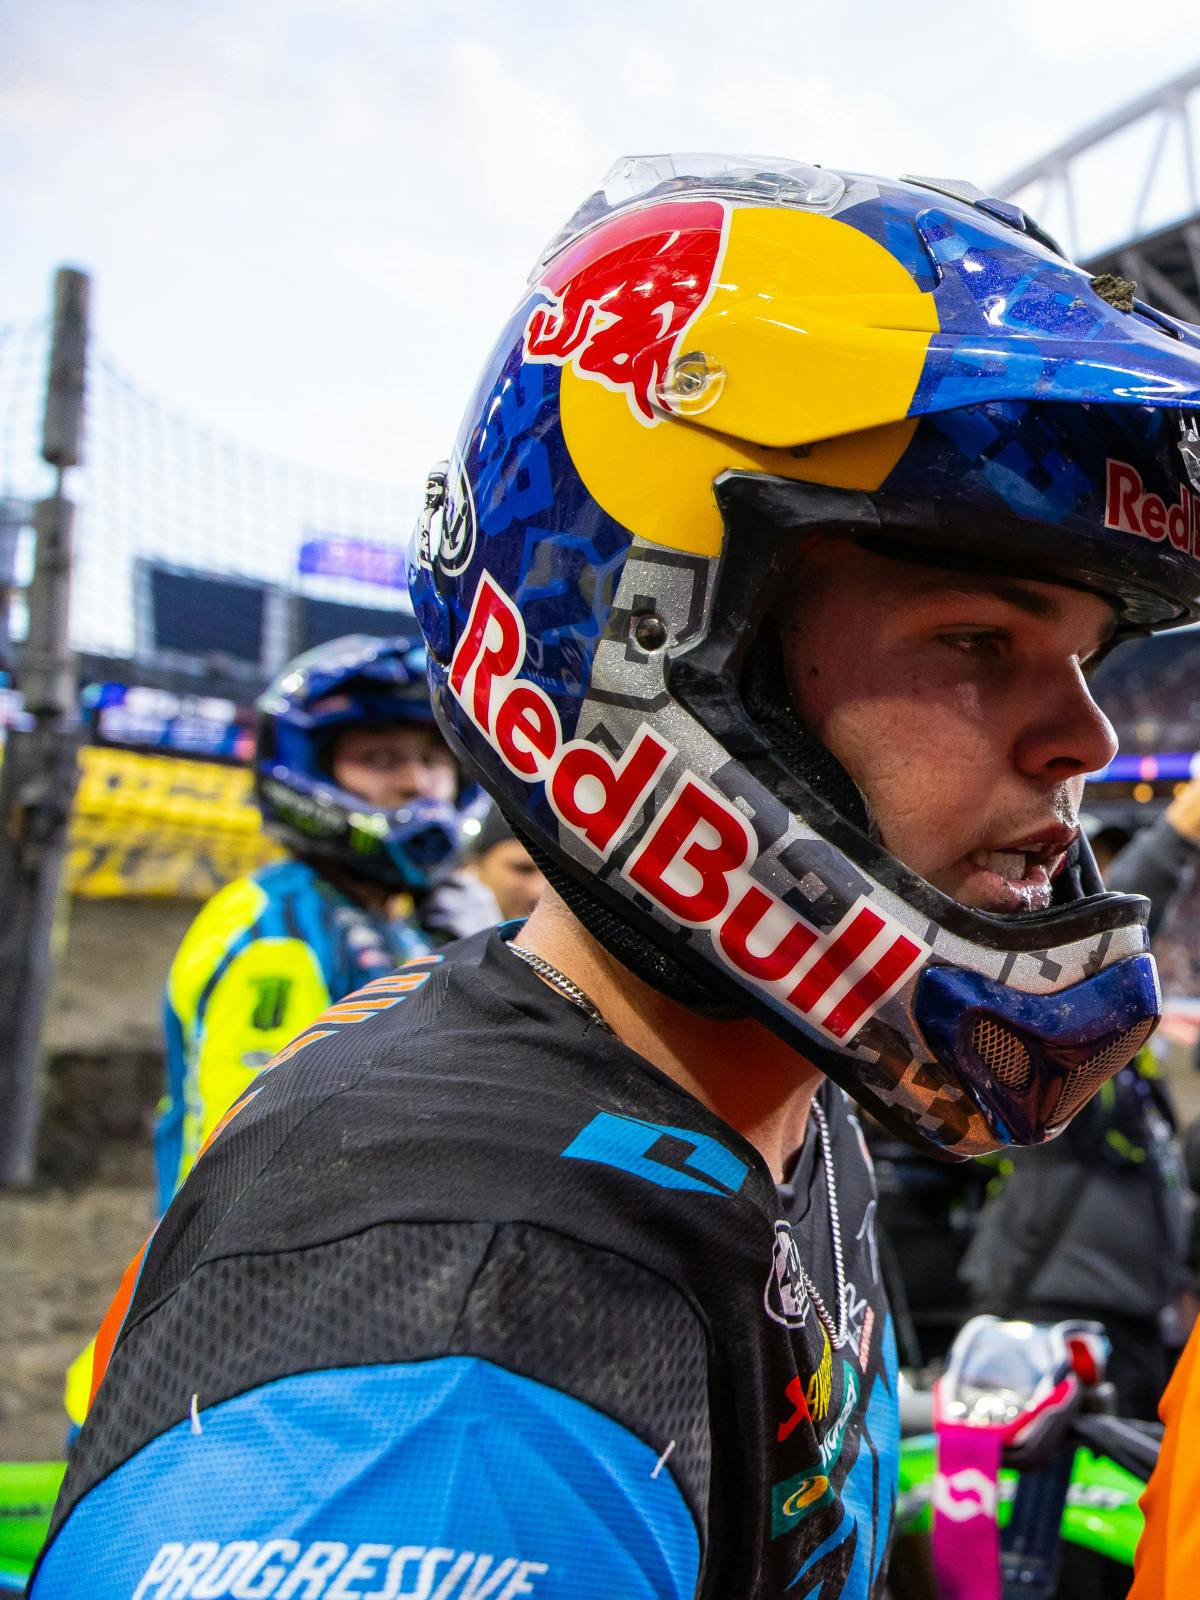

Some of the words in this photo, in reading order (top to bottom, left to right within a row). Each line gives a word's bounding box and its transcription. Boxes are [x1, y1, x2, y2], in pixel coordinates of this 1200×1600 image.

[1104, 458, 1191, 553] Red
[451, 574, 672, 858] Red
[626, 777, 927, 1042] Bull
[131, 1539, 550, 1600] PROGRESSIVE
